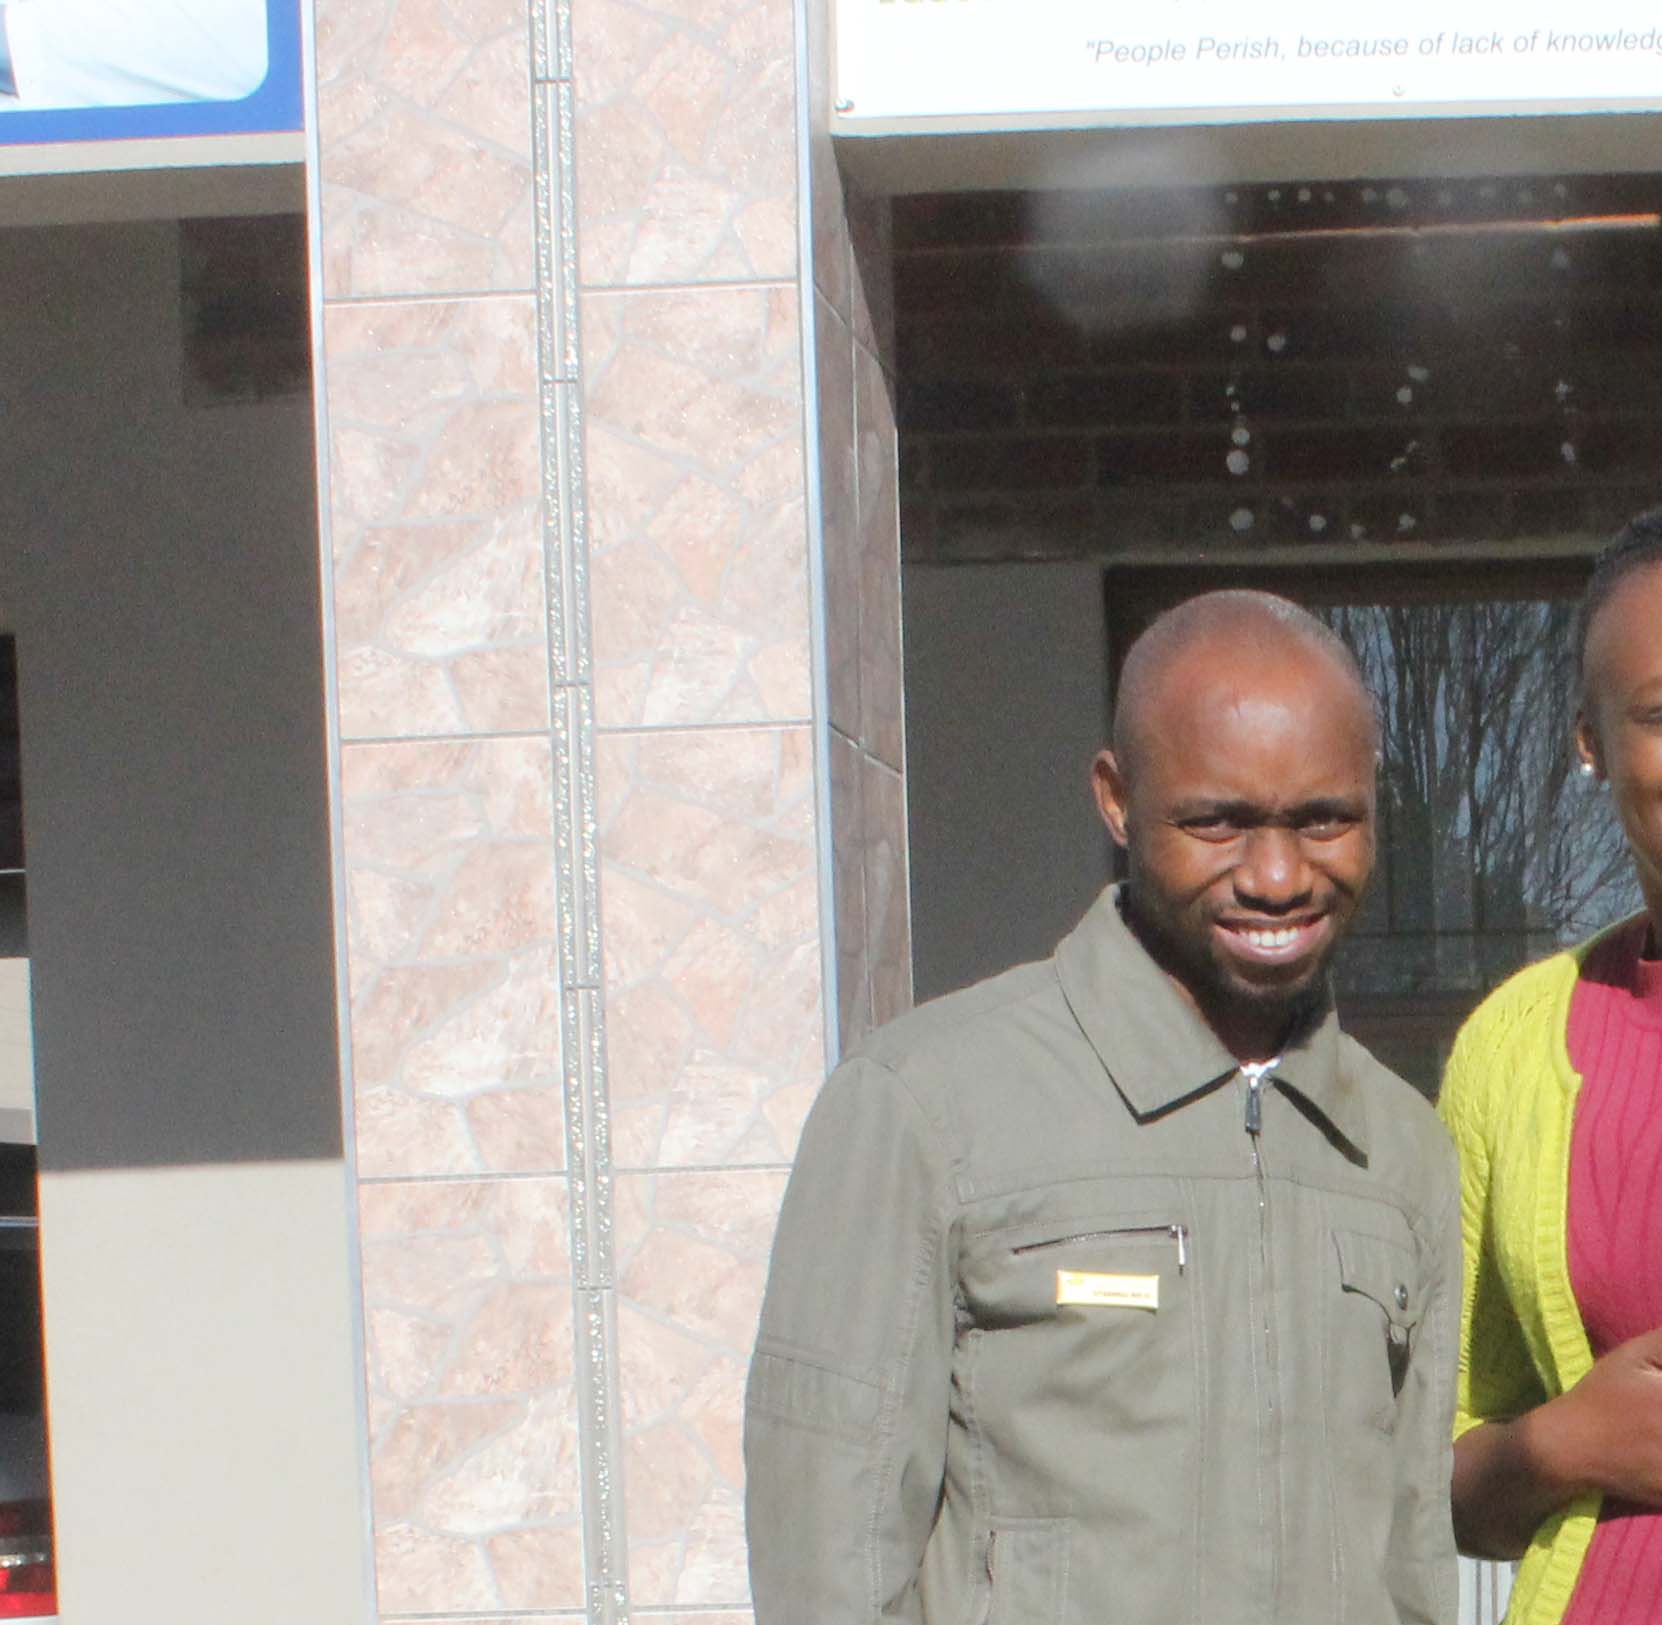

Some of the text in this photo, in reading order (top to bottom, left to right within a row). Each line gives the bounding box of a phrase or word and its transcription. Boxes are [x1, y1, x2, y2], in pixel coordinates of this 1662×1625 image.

[1086, 38, 1187, 66] "People
[1195, 36, 1287, 62] Perish,
[1297, 33, 1410, 59] because
[1418, 30, 1447, 56] of
[1451, 30, 1504, 56] lack
[1512, 28, 1542, 54] of
